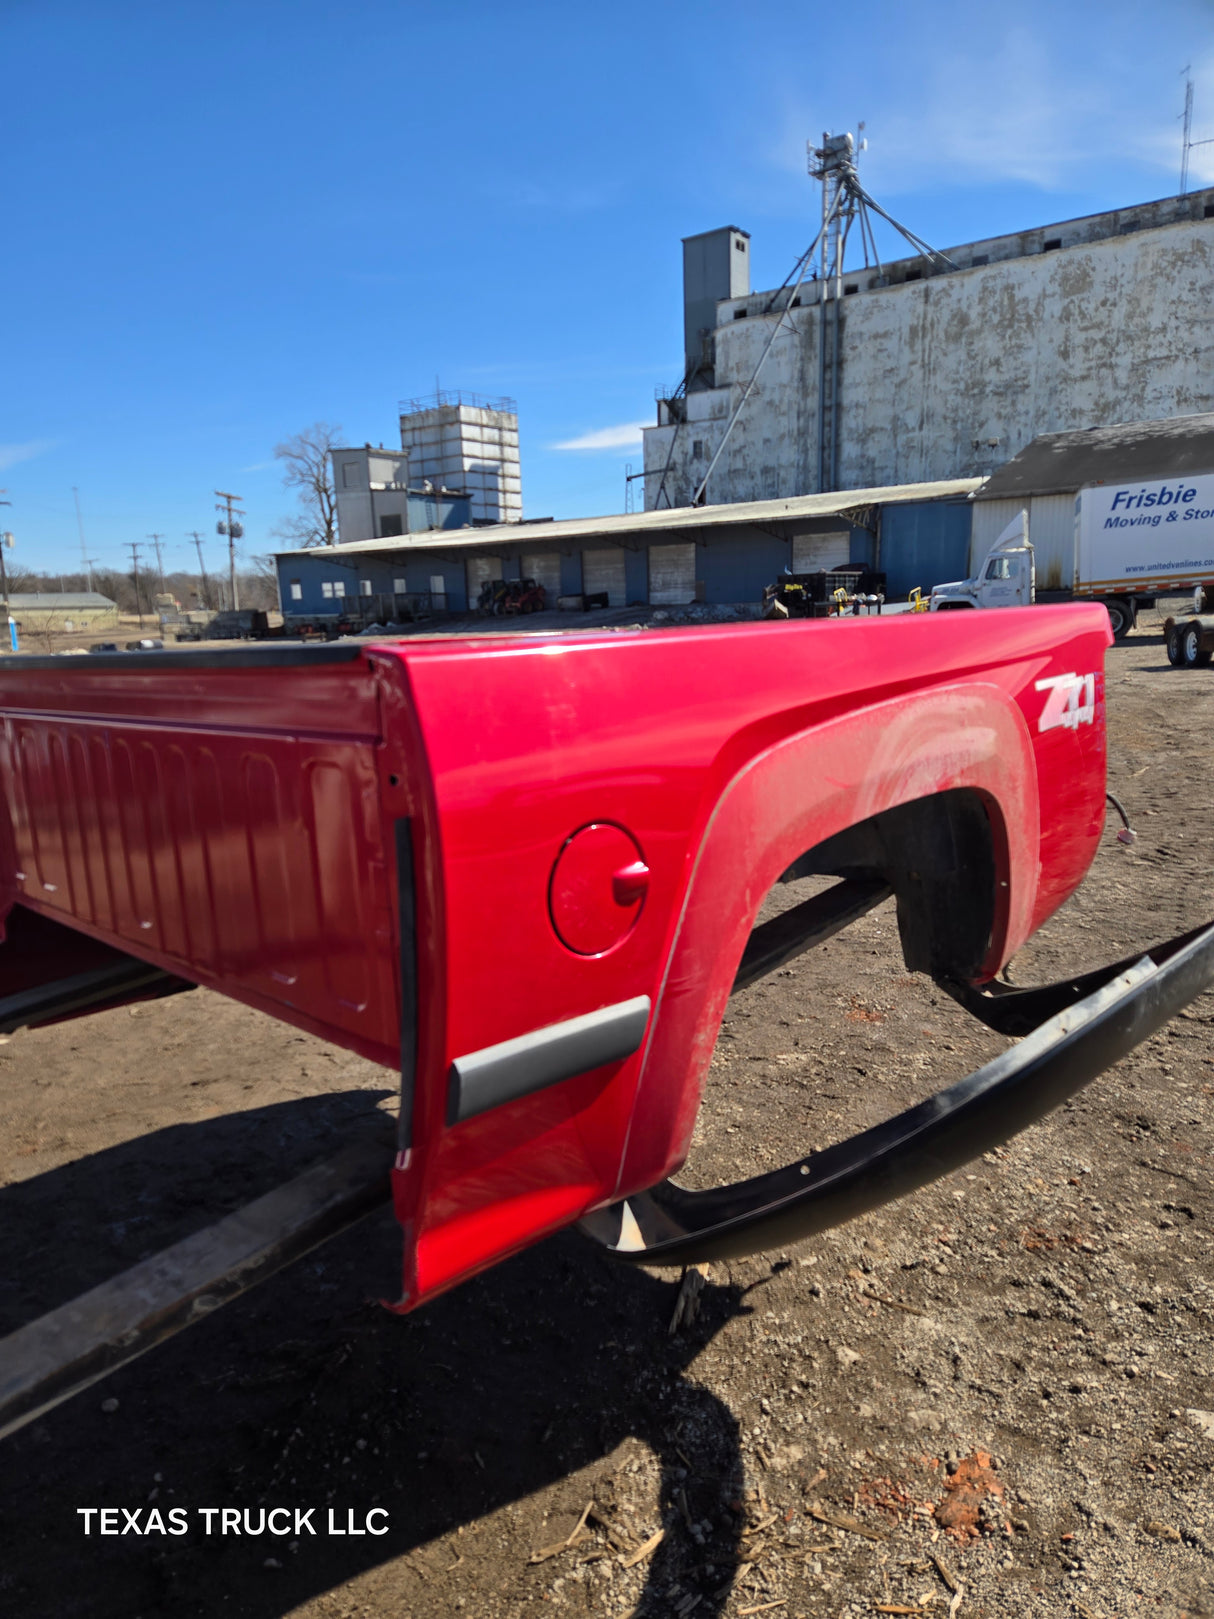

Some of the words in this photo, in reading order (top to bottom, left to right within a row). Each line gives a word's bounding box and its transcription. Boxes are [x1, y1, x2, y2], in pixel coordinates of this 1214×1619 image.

[1111, 485, 1197, 511] Frisbie
[1104, 514, 1161, 529] Moving
[1166, 510, 1179, 522] &
[1125, 559, 1214, 573] www.unitedvanlines.co
[1035, 672, 1095, 732] Z71
